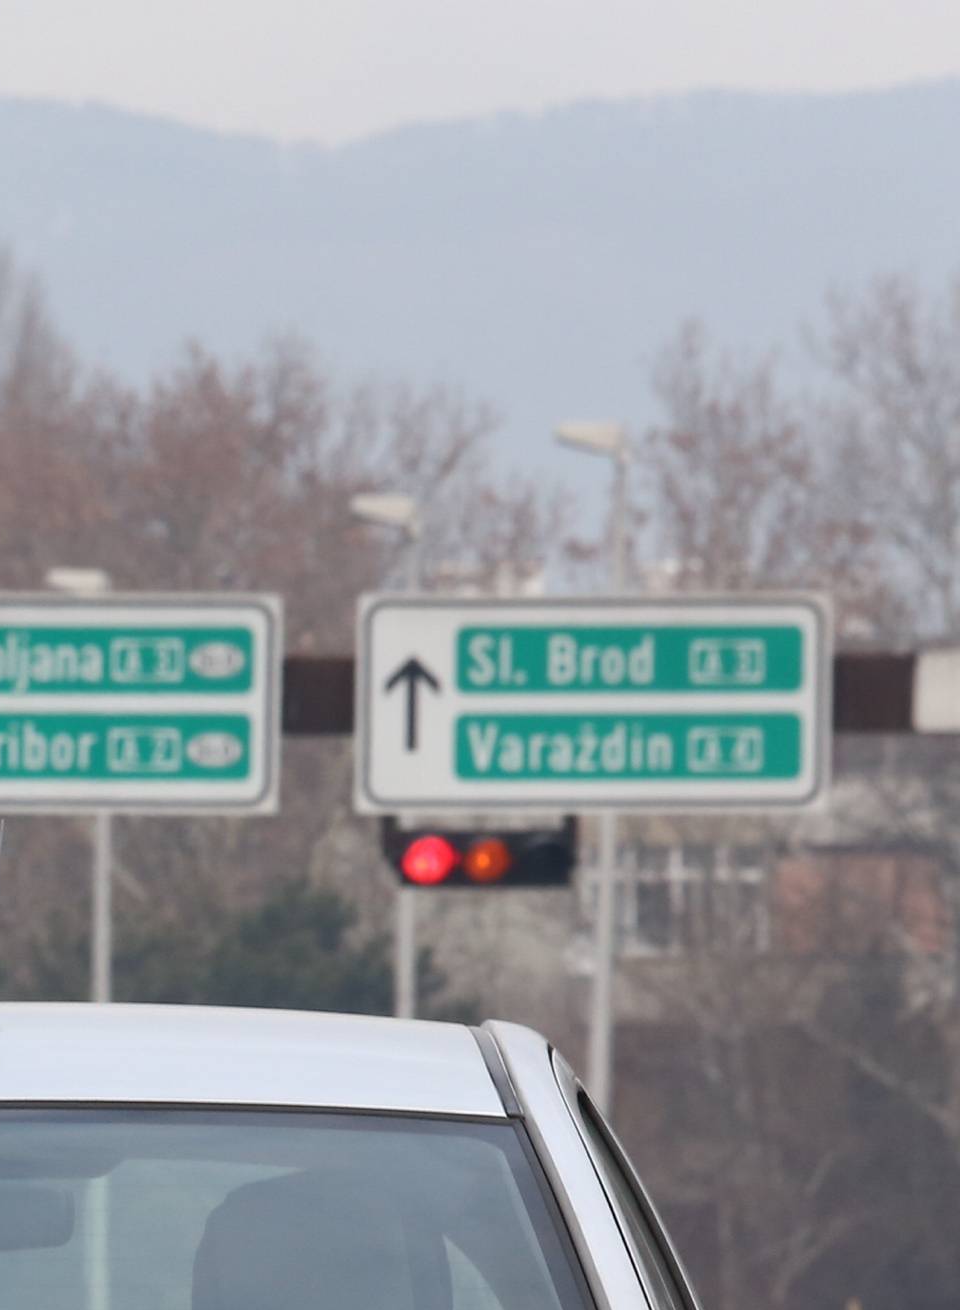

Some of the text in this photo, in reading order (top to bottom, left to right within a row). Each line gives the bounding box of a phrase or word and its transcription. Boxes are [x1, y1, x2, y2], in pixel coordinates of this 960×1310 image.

[467, 632, 527, 687] Sl.
[546, 633, 656, 686] Brod
[467, 722, 674, 774] Varaždin
